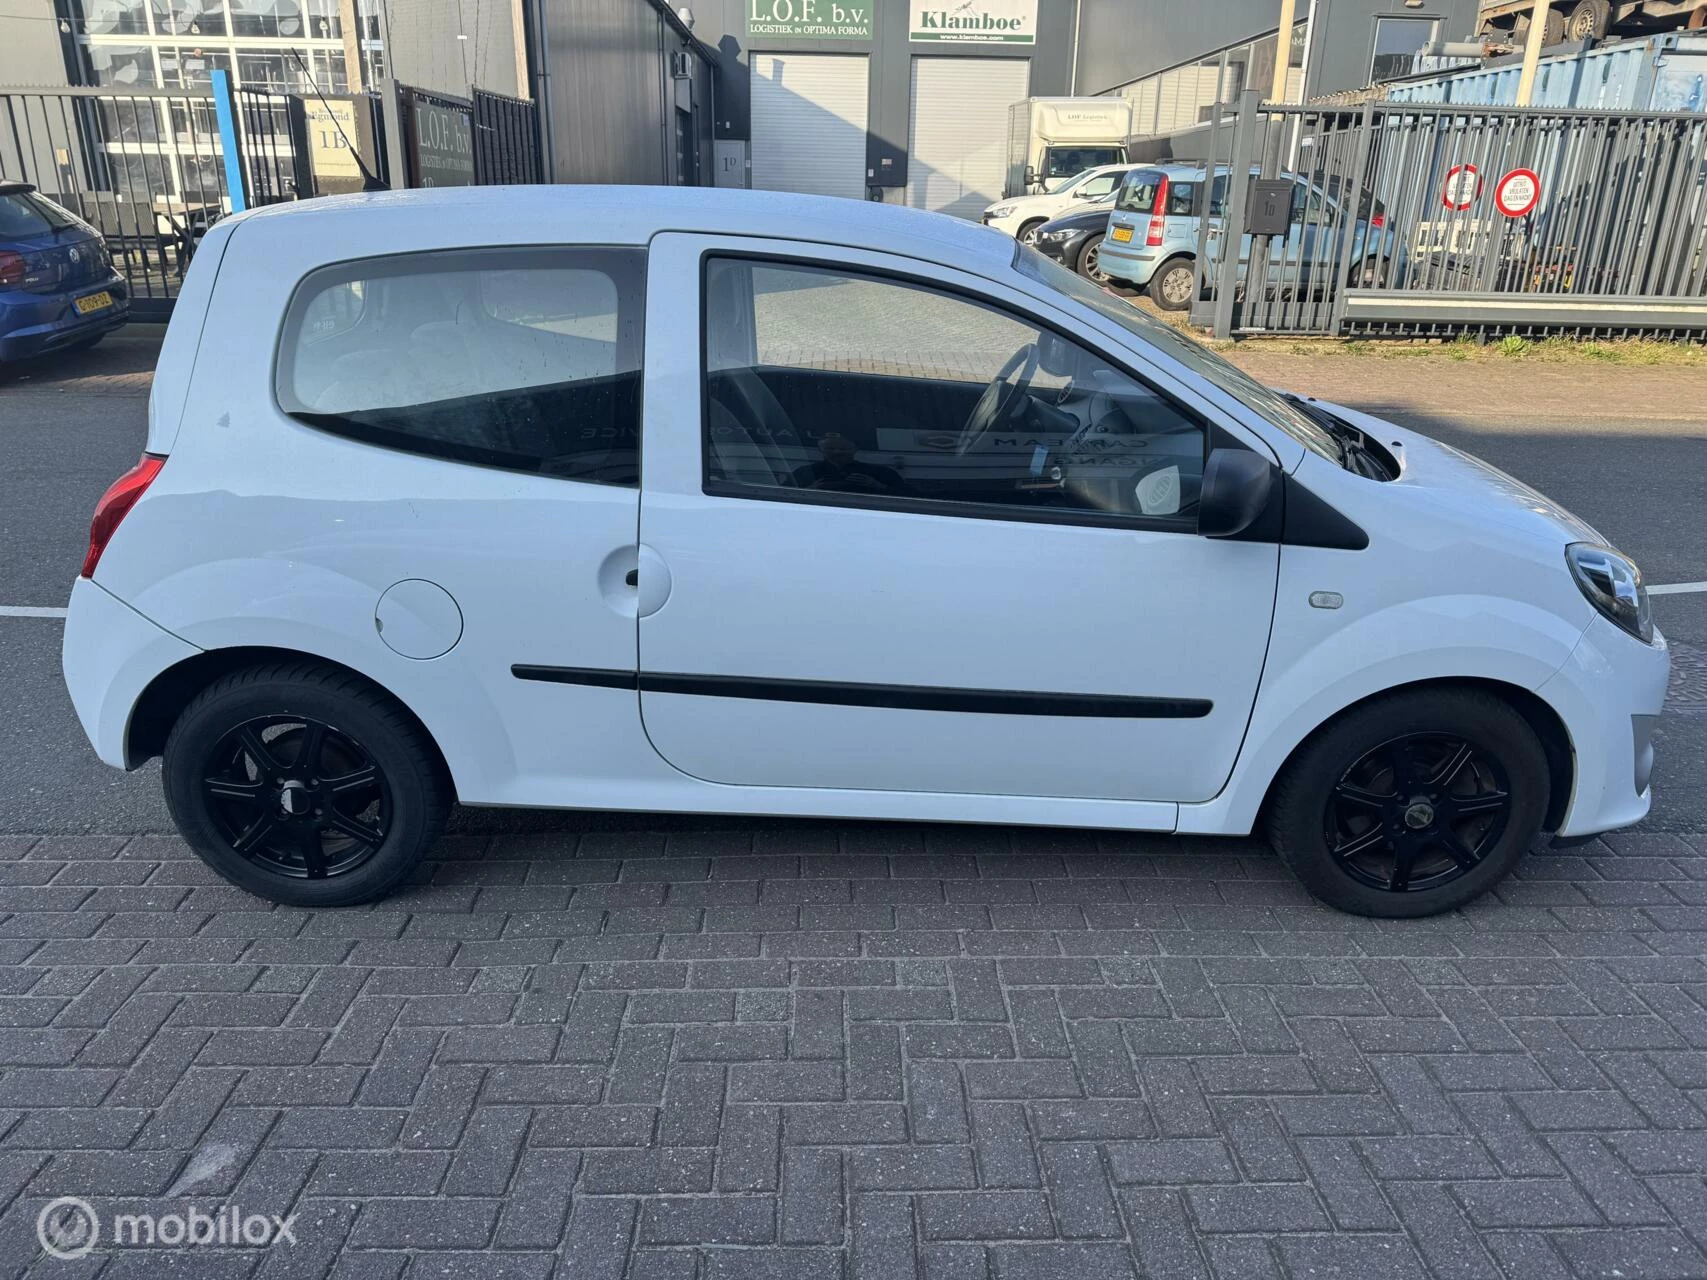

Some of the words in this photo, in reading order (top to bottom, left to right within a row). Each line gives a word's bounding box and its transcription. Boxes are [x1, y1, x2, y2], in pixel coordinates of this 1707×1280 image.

[750, 0, 822, 22] L.O.F.
[832, 3, 868, 23] b.v.
[920, 11, 1021, 30] Klamboe
[750, 24, 792, 33] LOGISTIEK
[803, 26, 836, 34] OPTIMA
[838, 27, 868, 35] FORMA
[416, 107, 453, 151] L.O.F.
